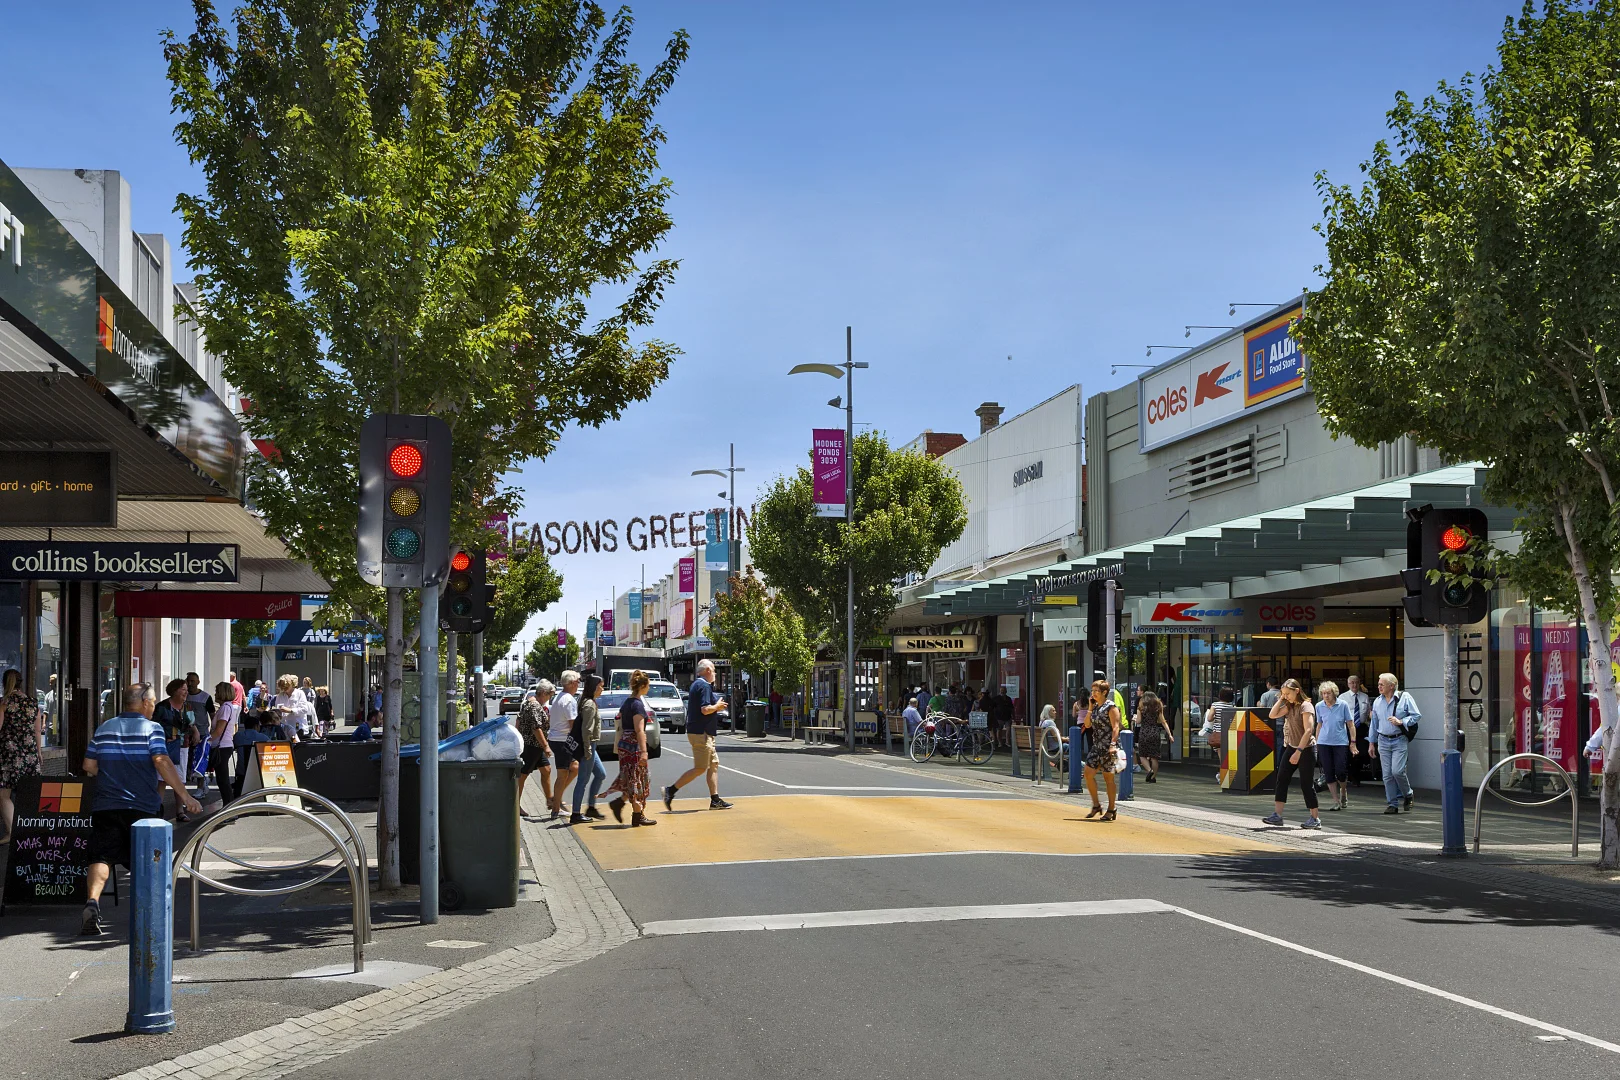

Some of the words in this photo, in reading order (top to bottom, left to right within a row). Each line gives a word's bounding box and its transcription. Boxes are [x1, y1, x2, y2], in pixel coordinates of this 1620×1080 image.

[1270, 337, 1296, 363] ALDI
[1270, 361, 1282, 375] Food
[1282, 358, 1296, 369] Store
[1194, 361, 1242, 408] Kmart
[1147, 386, 1188, 425] coles
[815, 440, 842, 448] MOONEE
[820, 457, 838, 465] 3039
[31, 481, 52, 493] gift
[64, 481, 93, 491] home
[12, 550, 88, 573] collins
[93, 551, 224, 575] booksellers
[1150, 603, 1244, 622] Kmart
[1259, 603, 1317, 621] coles
[301, 629, 339, 642] ANZ
[1519, 632, 1530, 644] ALL
[1545, 632, 1562, 644] NEED
[1562, 631, 1570, 643] IS
[907, 639, 964, 649] sussan
[1458, 633, 1483, 722] dotti
[17, 815, 55, 830] homing
[58, 816, 93, 828] instinct
[17, 837, 43, 851] XMAS
[48, 837, 68, 848] MAY
[74, 838, 88, 849] BE
[16, 865, 31, 876] BUT
[38, 864, 54, 874] THE
[60, 865, 88, 875] SALES
[26, 873, 50, 884] HAVE
[55, 875, 76, 885] JUST
